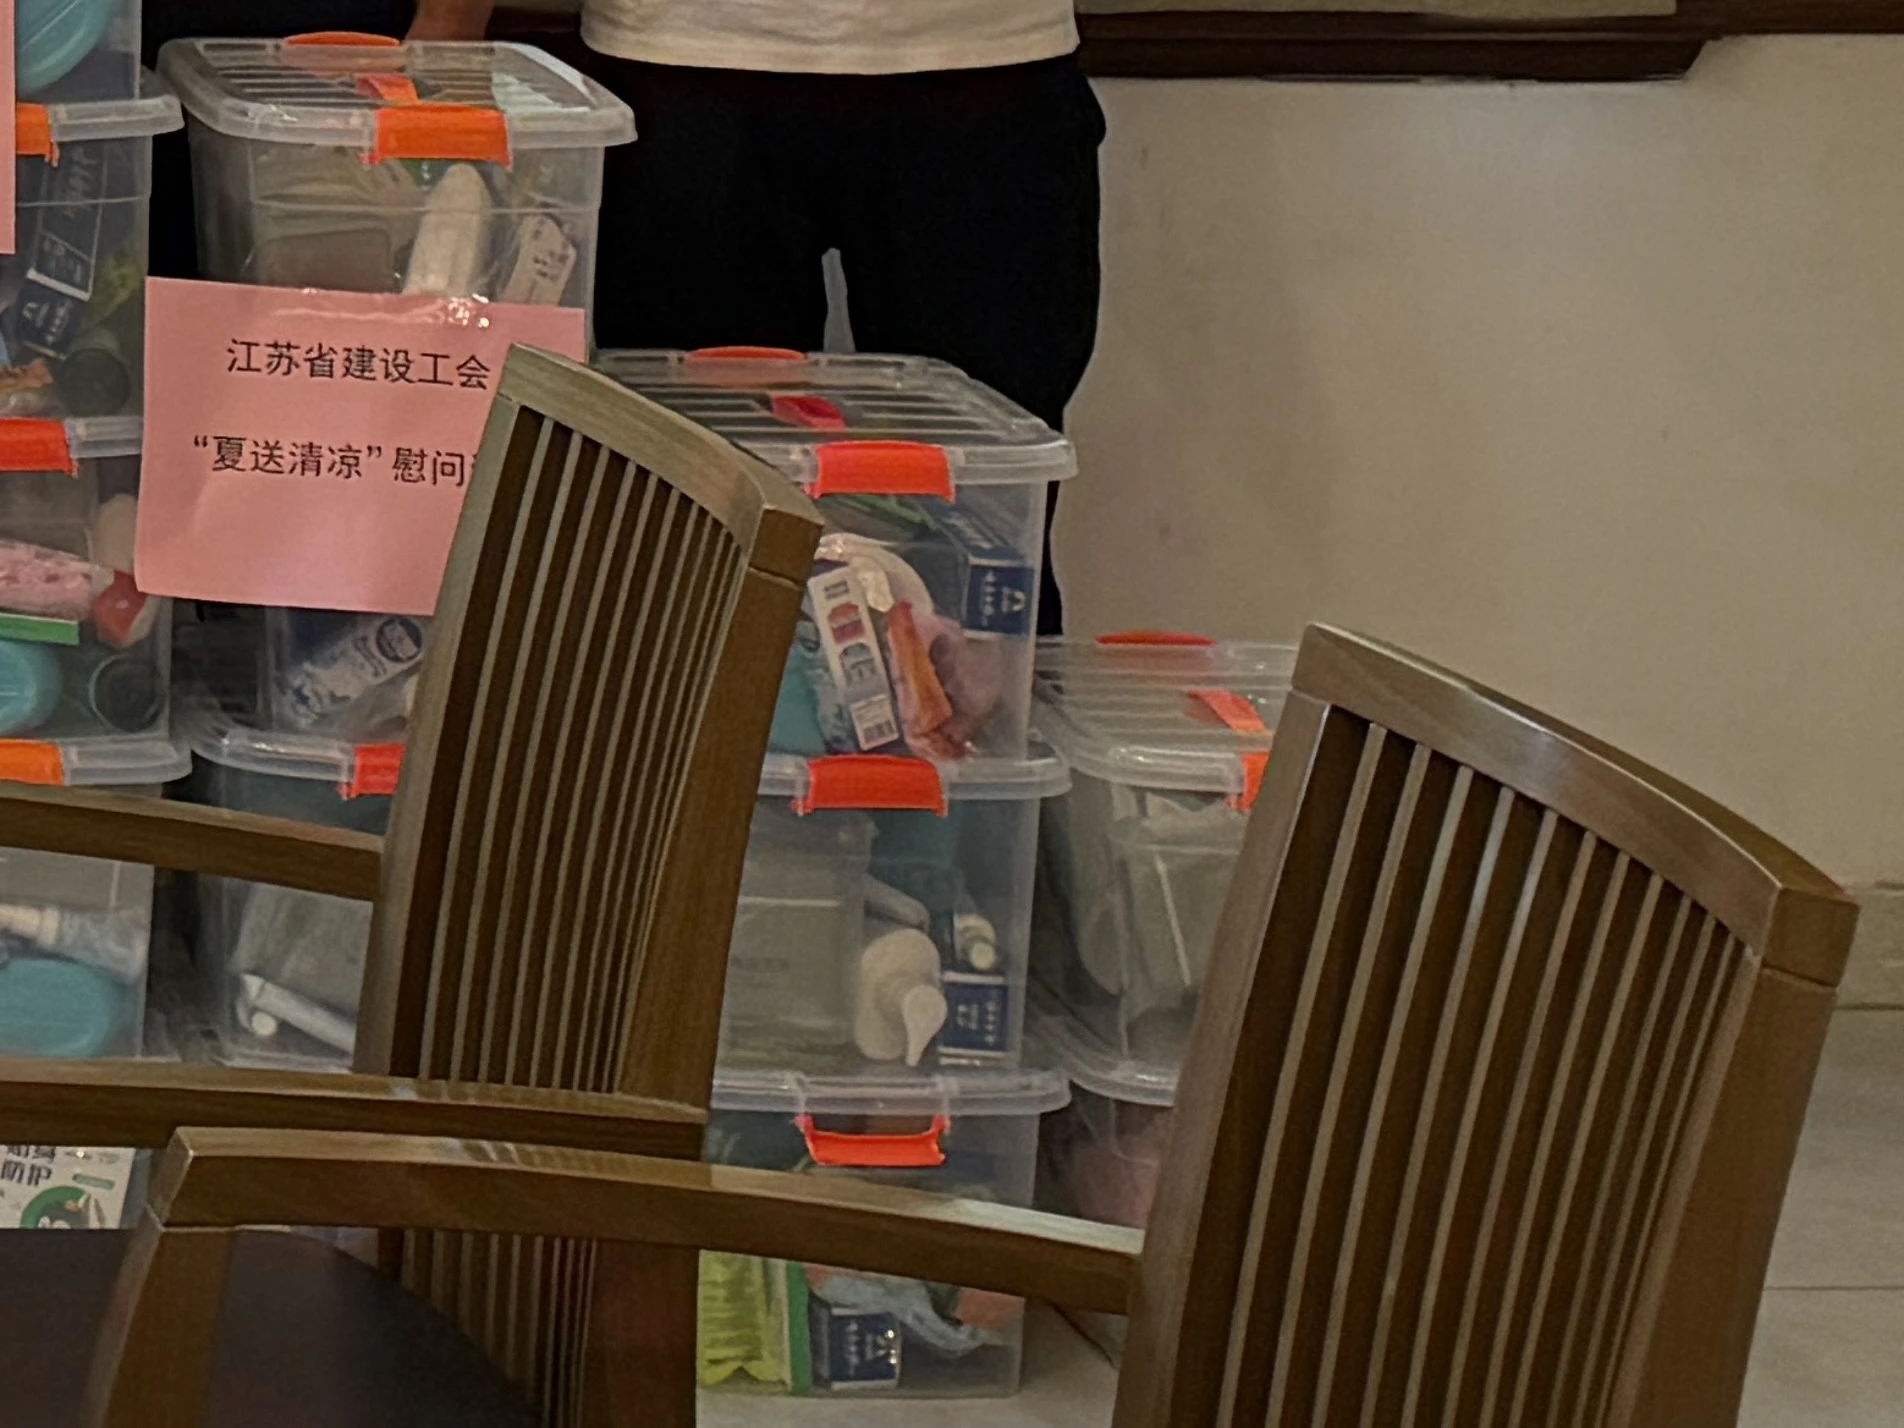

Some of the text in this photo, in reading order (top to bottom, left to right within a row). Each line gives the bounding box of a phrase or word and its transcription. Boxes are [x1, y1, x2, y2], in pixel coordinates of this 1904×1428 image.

[226, 339, 490, 390] 江苏省建设工会
[193, 436, 478, 488] “夏送清凉”慰问
